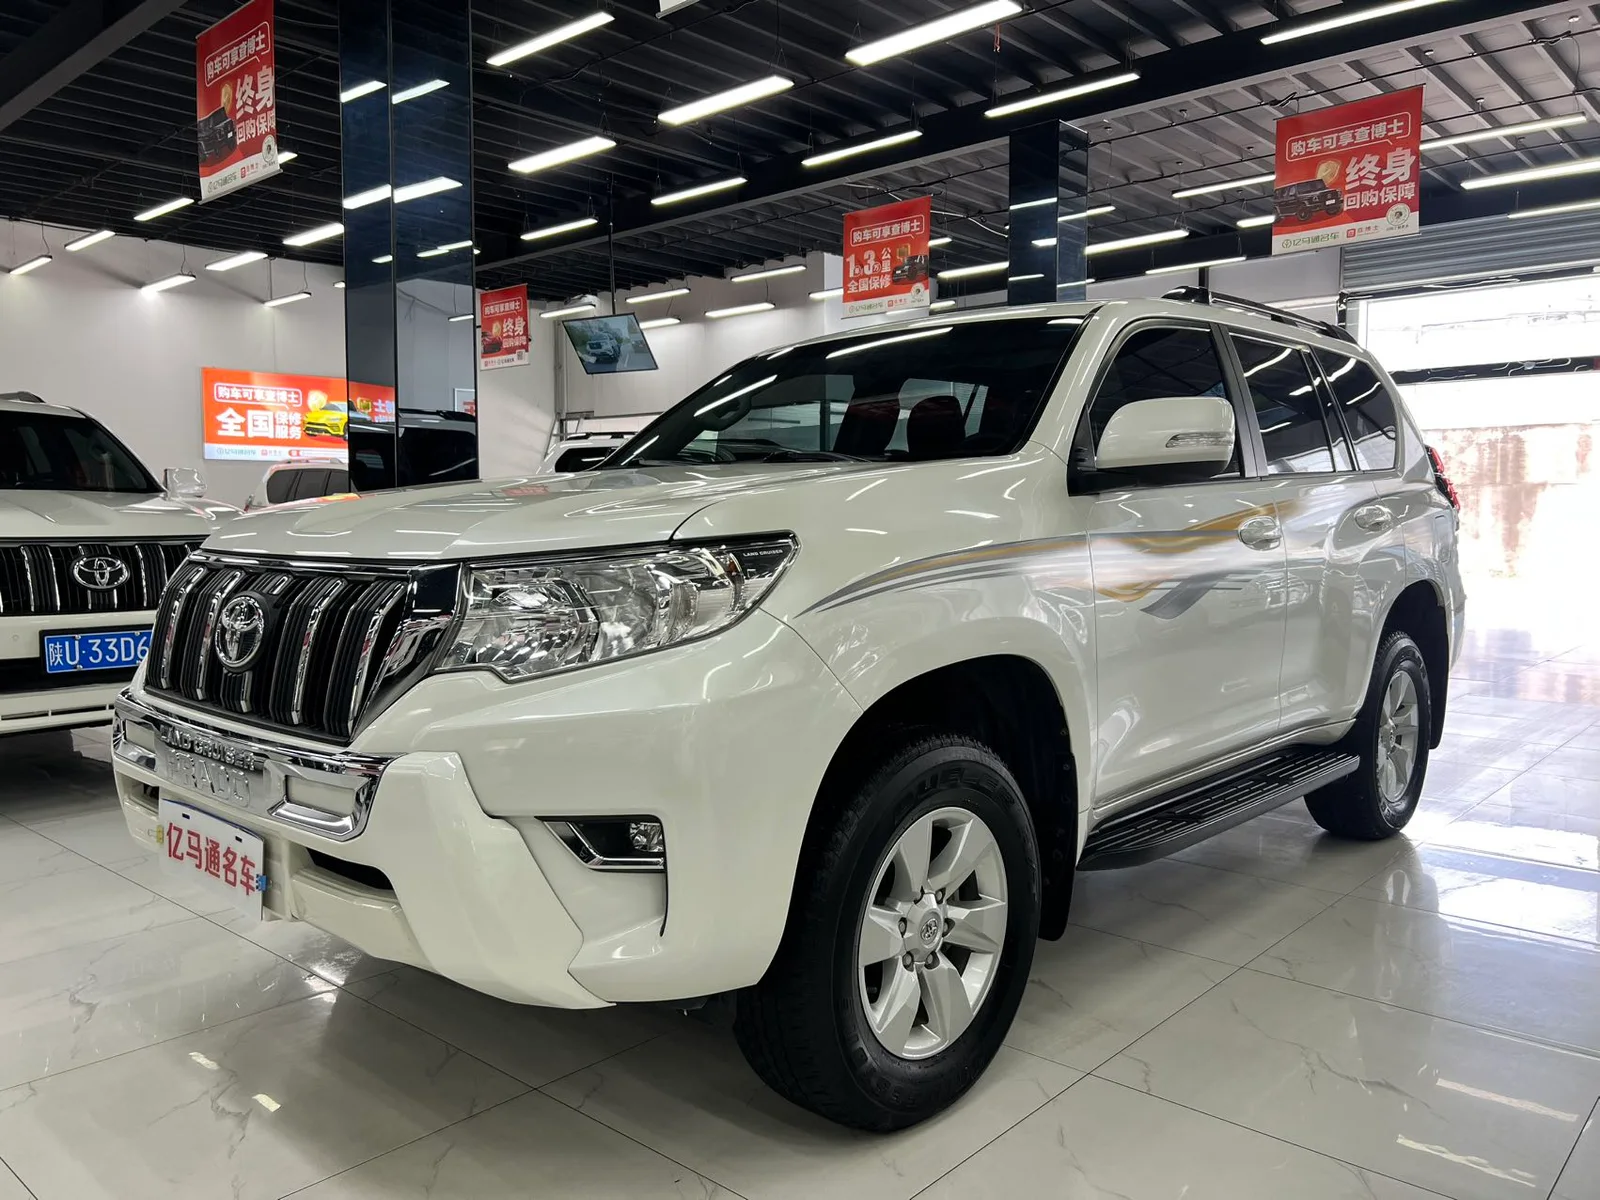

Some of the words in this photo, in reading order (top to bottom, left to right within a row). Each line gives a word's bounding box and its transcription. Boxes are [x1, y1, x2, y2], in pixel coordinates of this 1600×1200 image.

[206, 30, 266, 82] 购车可享查博士
[235, 65, 275, 120] 终身
[1291, 119, 1404, 157] 购车可享查博士
[1345, 147, 1416, 190] 终身
[1344, 182, 1415, 211] 回购保障
[853, 219, 920, 244] 购车可享查博士
[847, 274, 892, 293] 全国保修
[503, 317, 526, 337] 终身
[217, 386, 299, 403] 购车可享查博士
[216, 407, 274, 438] 全国
[160, 724, 191, 750] LAND
[193, 736, 254, 771] CRUISER
[166, 749, 250, 808] PRADO
[166, 822, 256, 896] 亿马通名车
